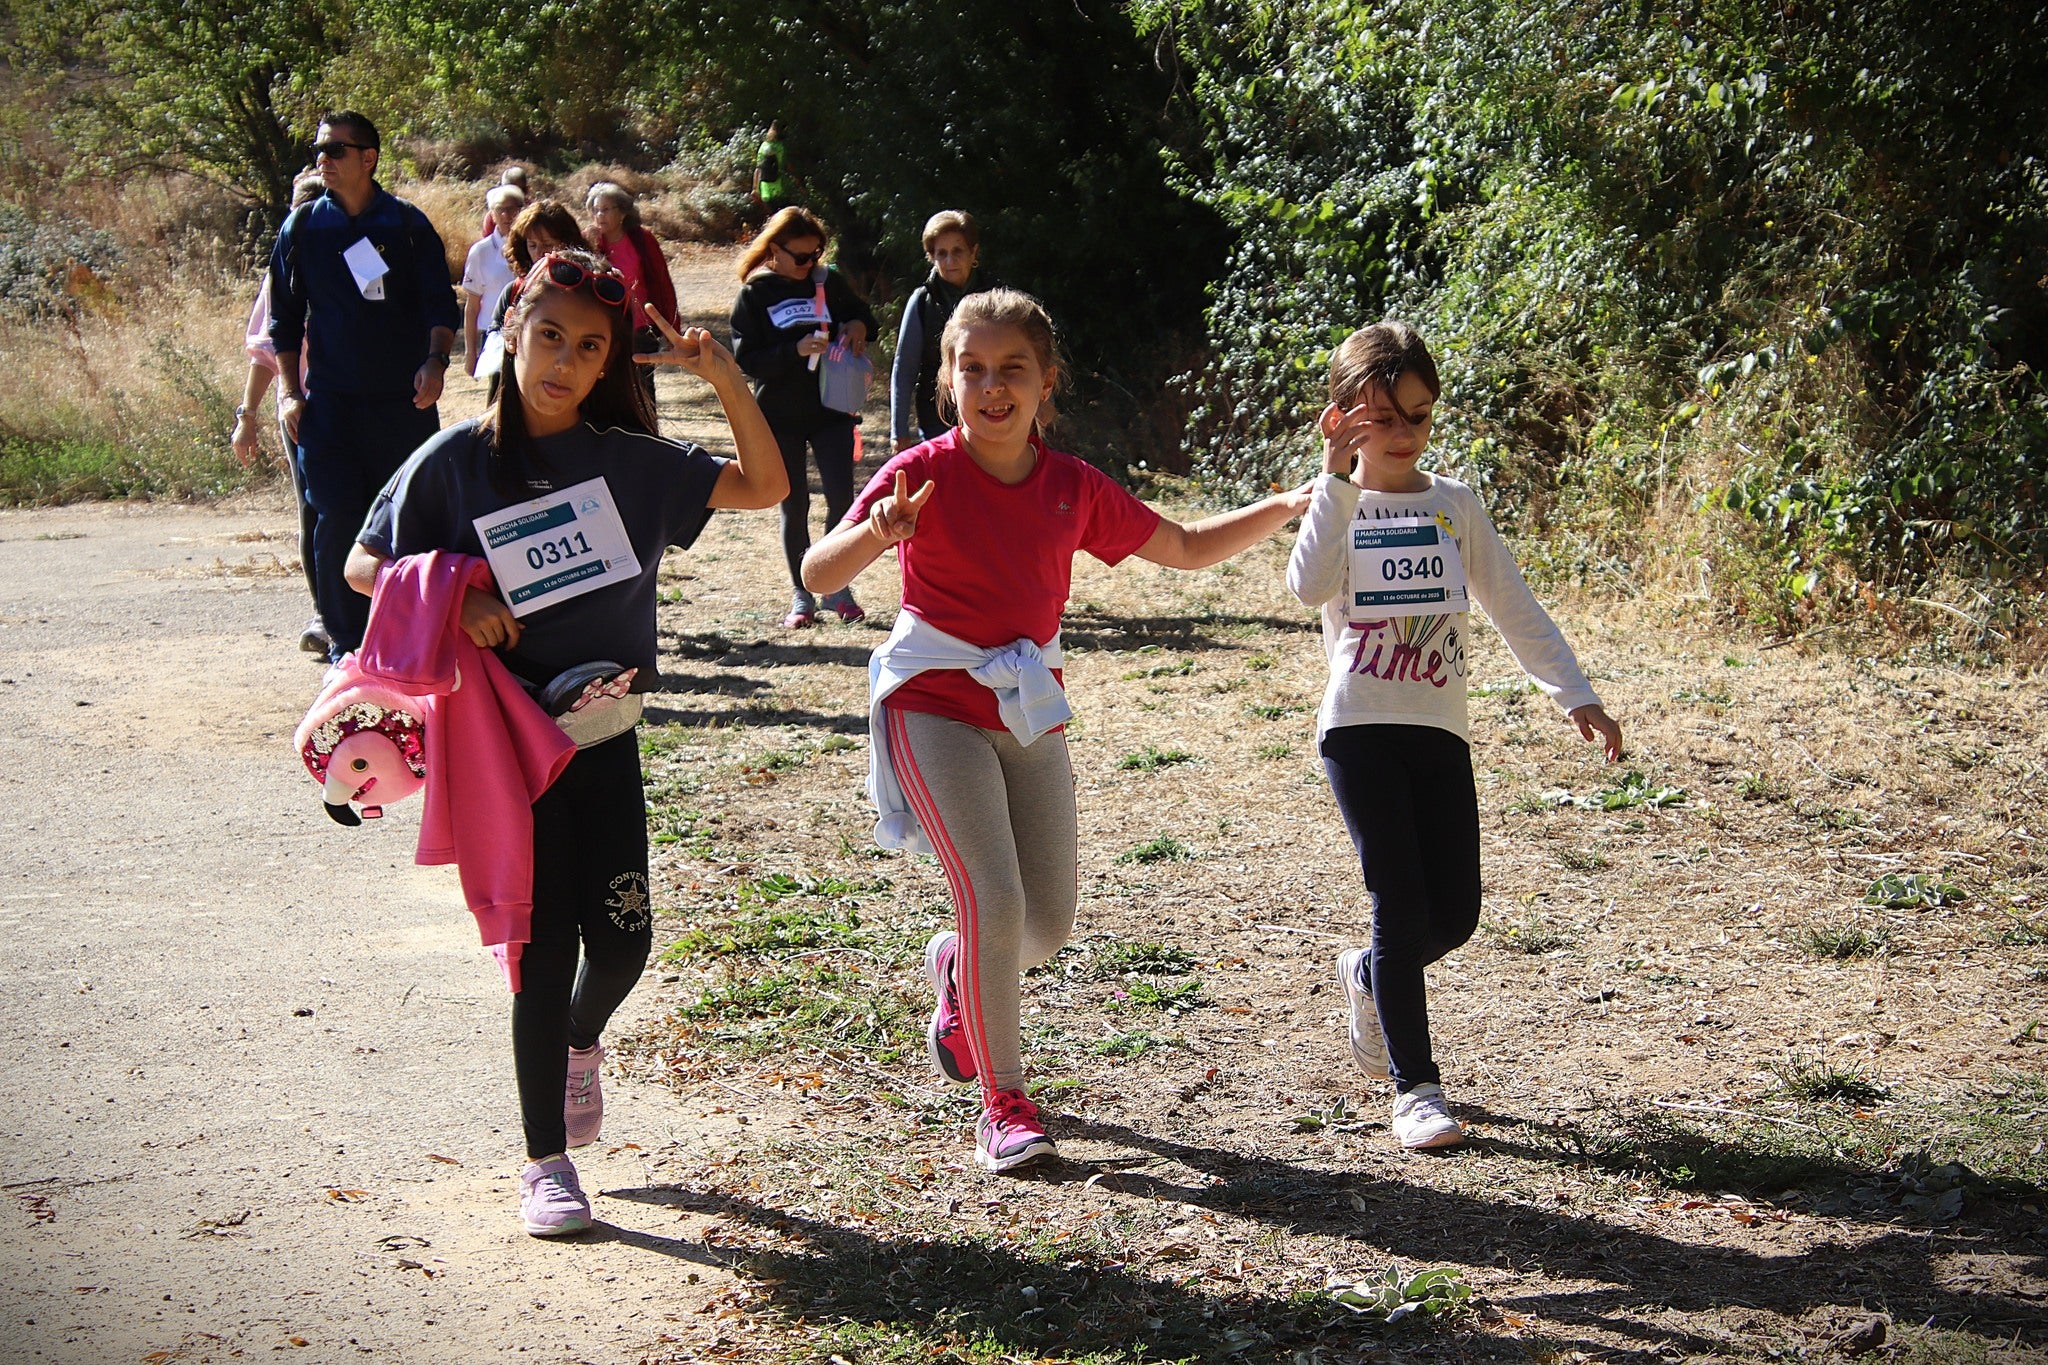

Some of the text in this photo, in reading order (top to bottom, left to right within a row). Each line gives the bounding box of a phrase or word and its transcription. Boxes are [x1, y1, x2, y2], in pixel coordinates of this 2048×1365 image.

[491, 521, 518, 535] MARCHA
[518, 511, 549, 526] SOLIDARIA
[1386, 528, 1417, 536] SOLIDARIA
[489, 531, 518, 546] FAMILIAR
[1356, 538, 1382, 546] FAMILIAR
[526, 531, 593, 570] 0311
[551, 579, 557, 587] de
[557, 571, 580, 584] OCTUBRE
[586, 565, 599, 575] 2025
[1382, 555, 1444, 581] 0340
[1348, 620, 1448, 688] Time
[608, 912, 625, 930] ALL
